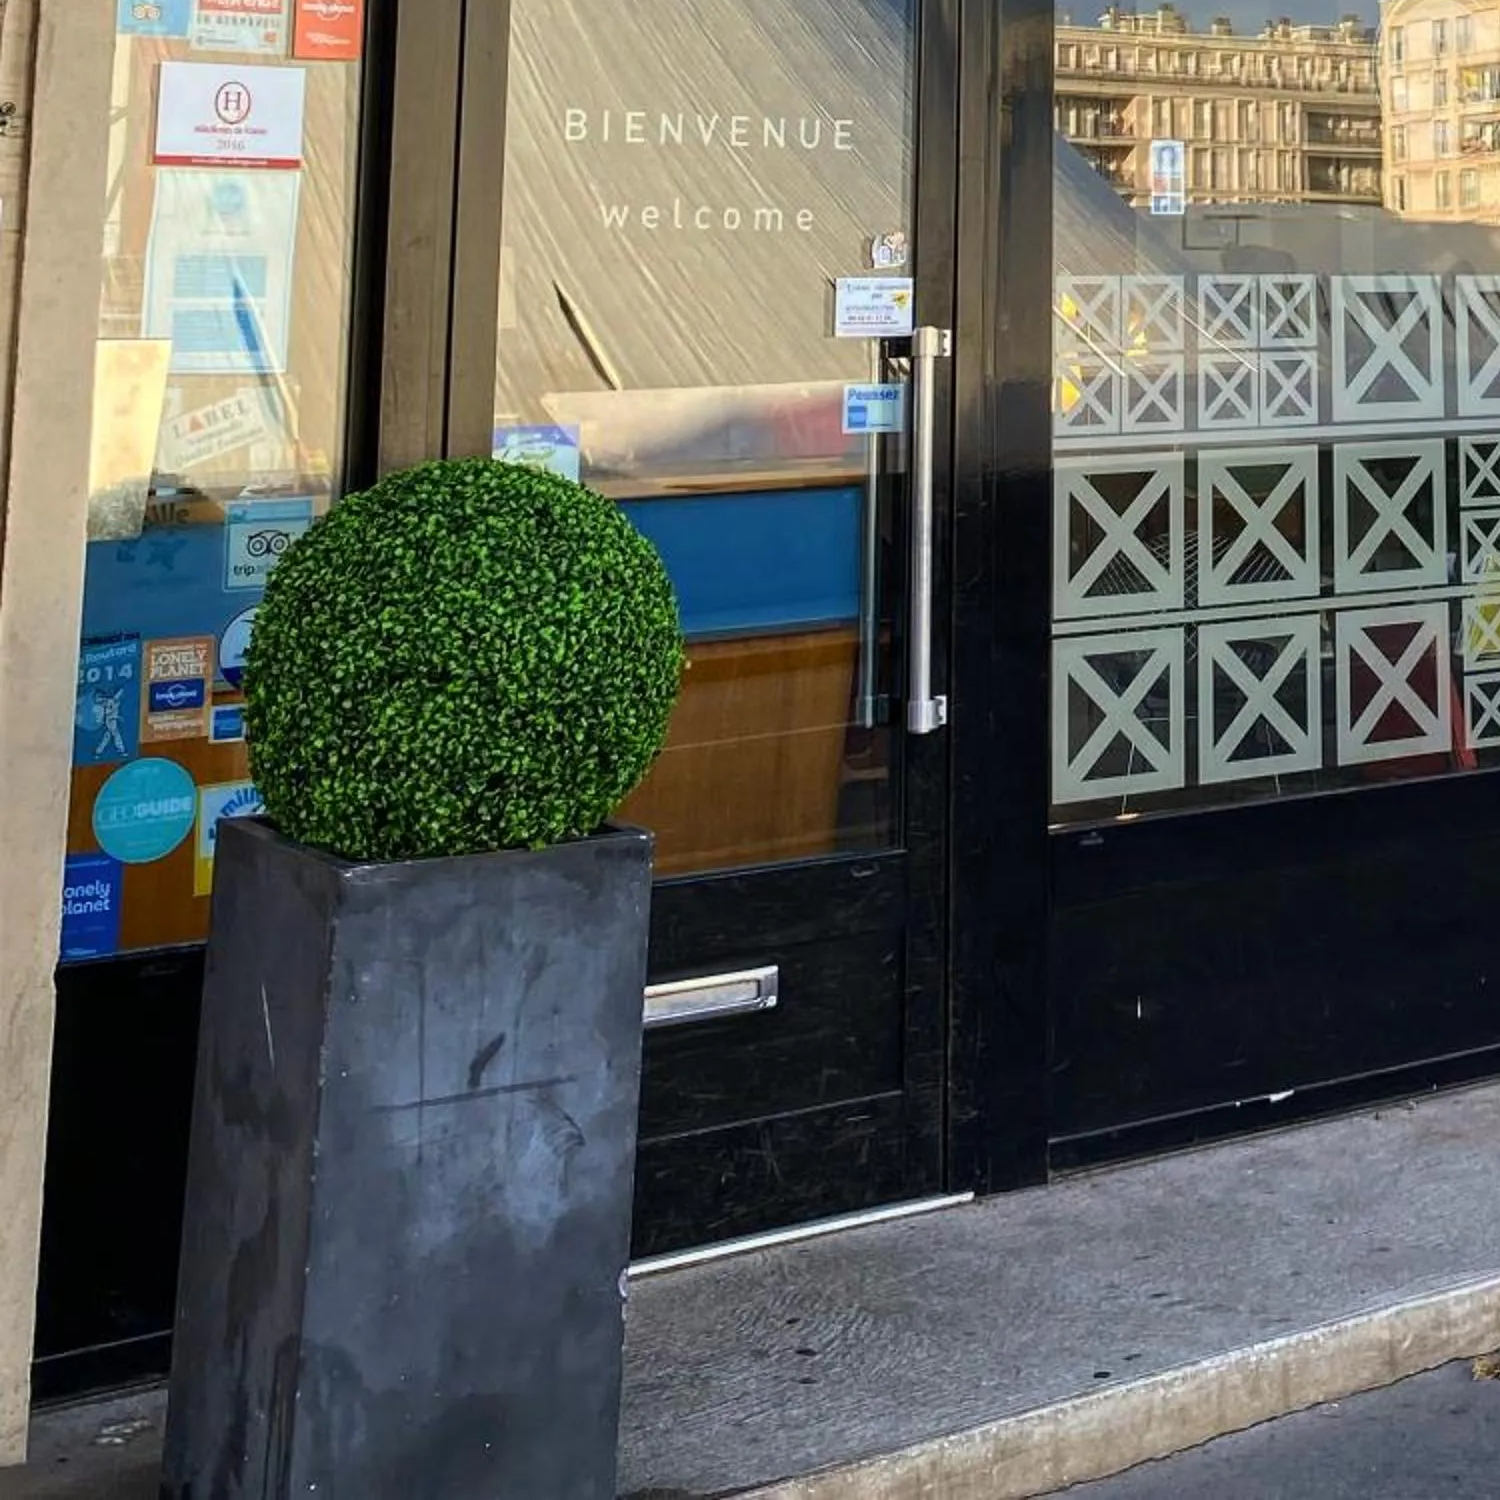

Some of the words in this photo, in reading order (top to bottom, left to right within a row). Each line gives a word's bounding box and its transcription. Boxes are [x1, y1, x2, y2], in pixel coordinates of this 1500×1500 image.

[223, 90, 242, 112] H
[564, 108, 855, 151] BIENVENUE
[601, 198, 815, 231] welcome
[151, 648, 207, 667] LONELY
[150, 662, 207, 679] PLANET
